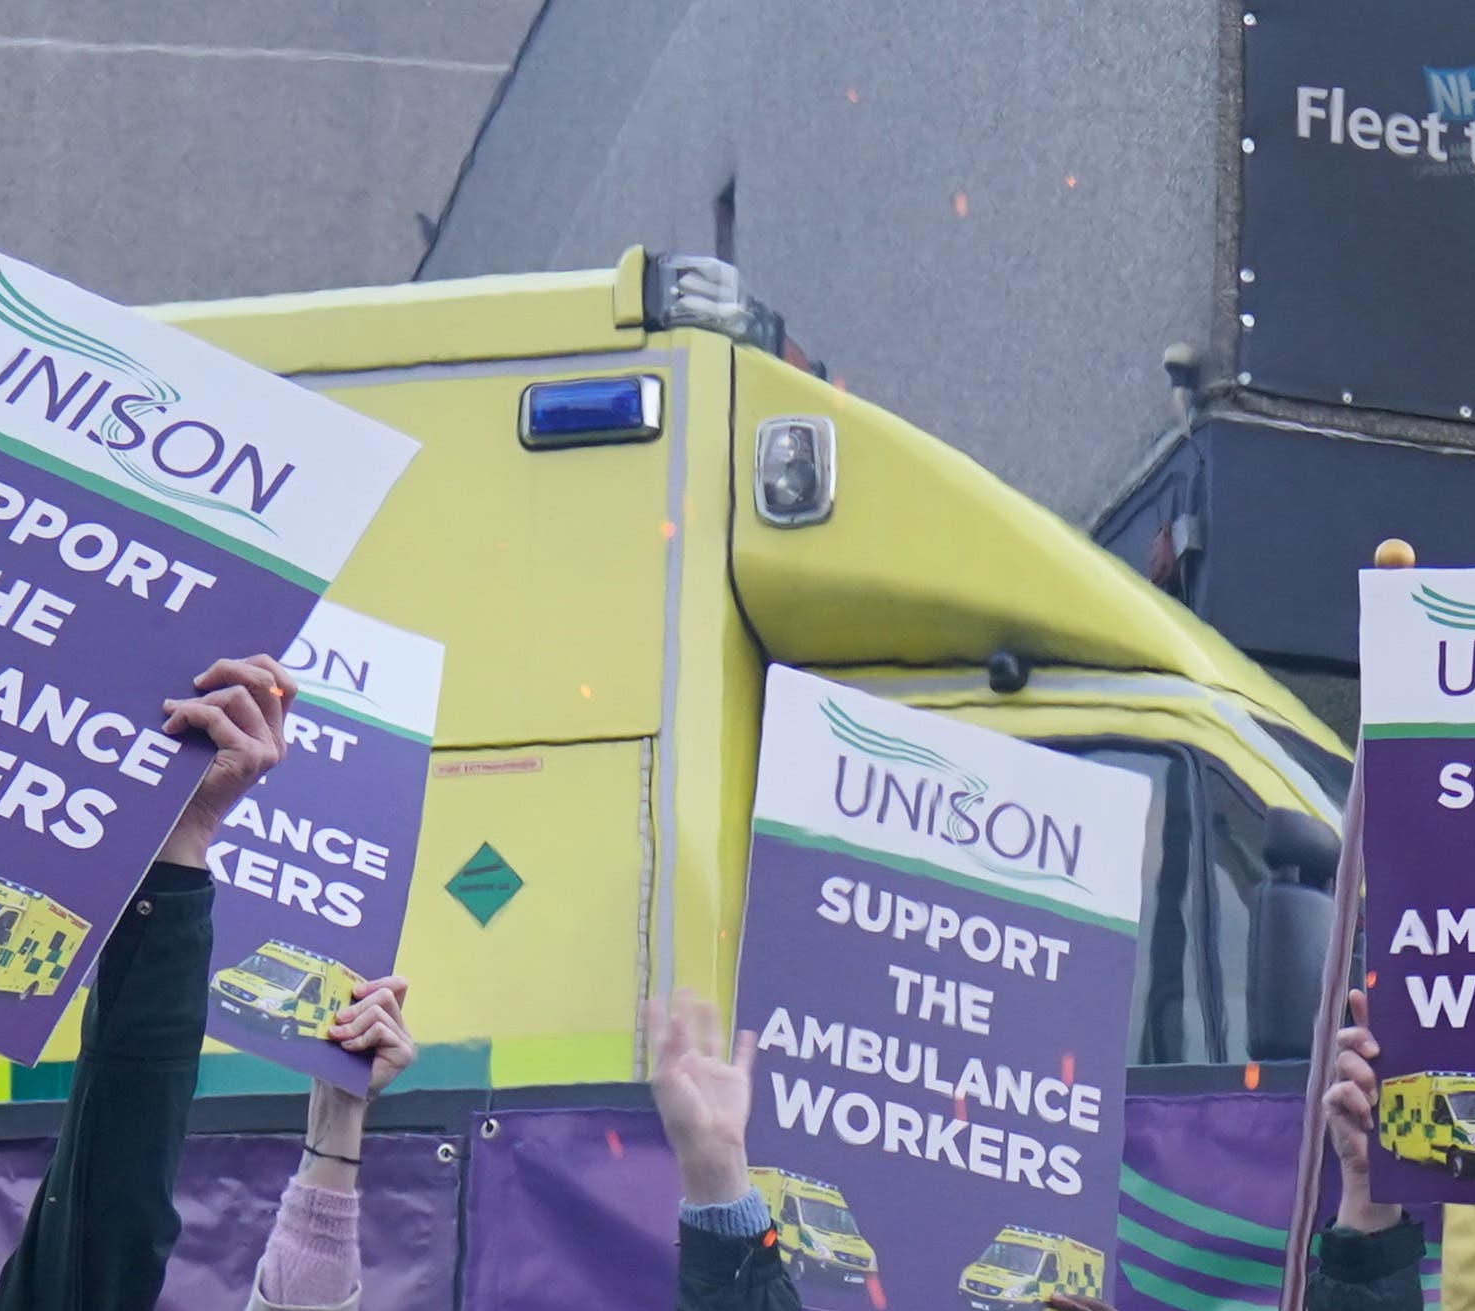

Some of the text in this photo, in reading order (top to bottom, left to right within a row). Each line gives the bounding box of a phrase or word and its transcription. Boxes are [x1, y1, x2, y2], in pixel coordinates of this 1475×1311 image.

[1296, 86, 1448, 162] Fleet
[835, 756, 1081, 876] UNISON
[817, 876, 1070, 982] SUPPORT
[888, 965, 994, 1035] THE
[758, 1007, 1102, 1132] AMBULANCE
[770, 1072, 1082, 1196] WORKERS
